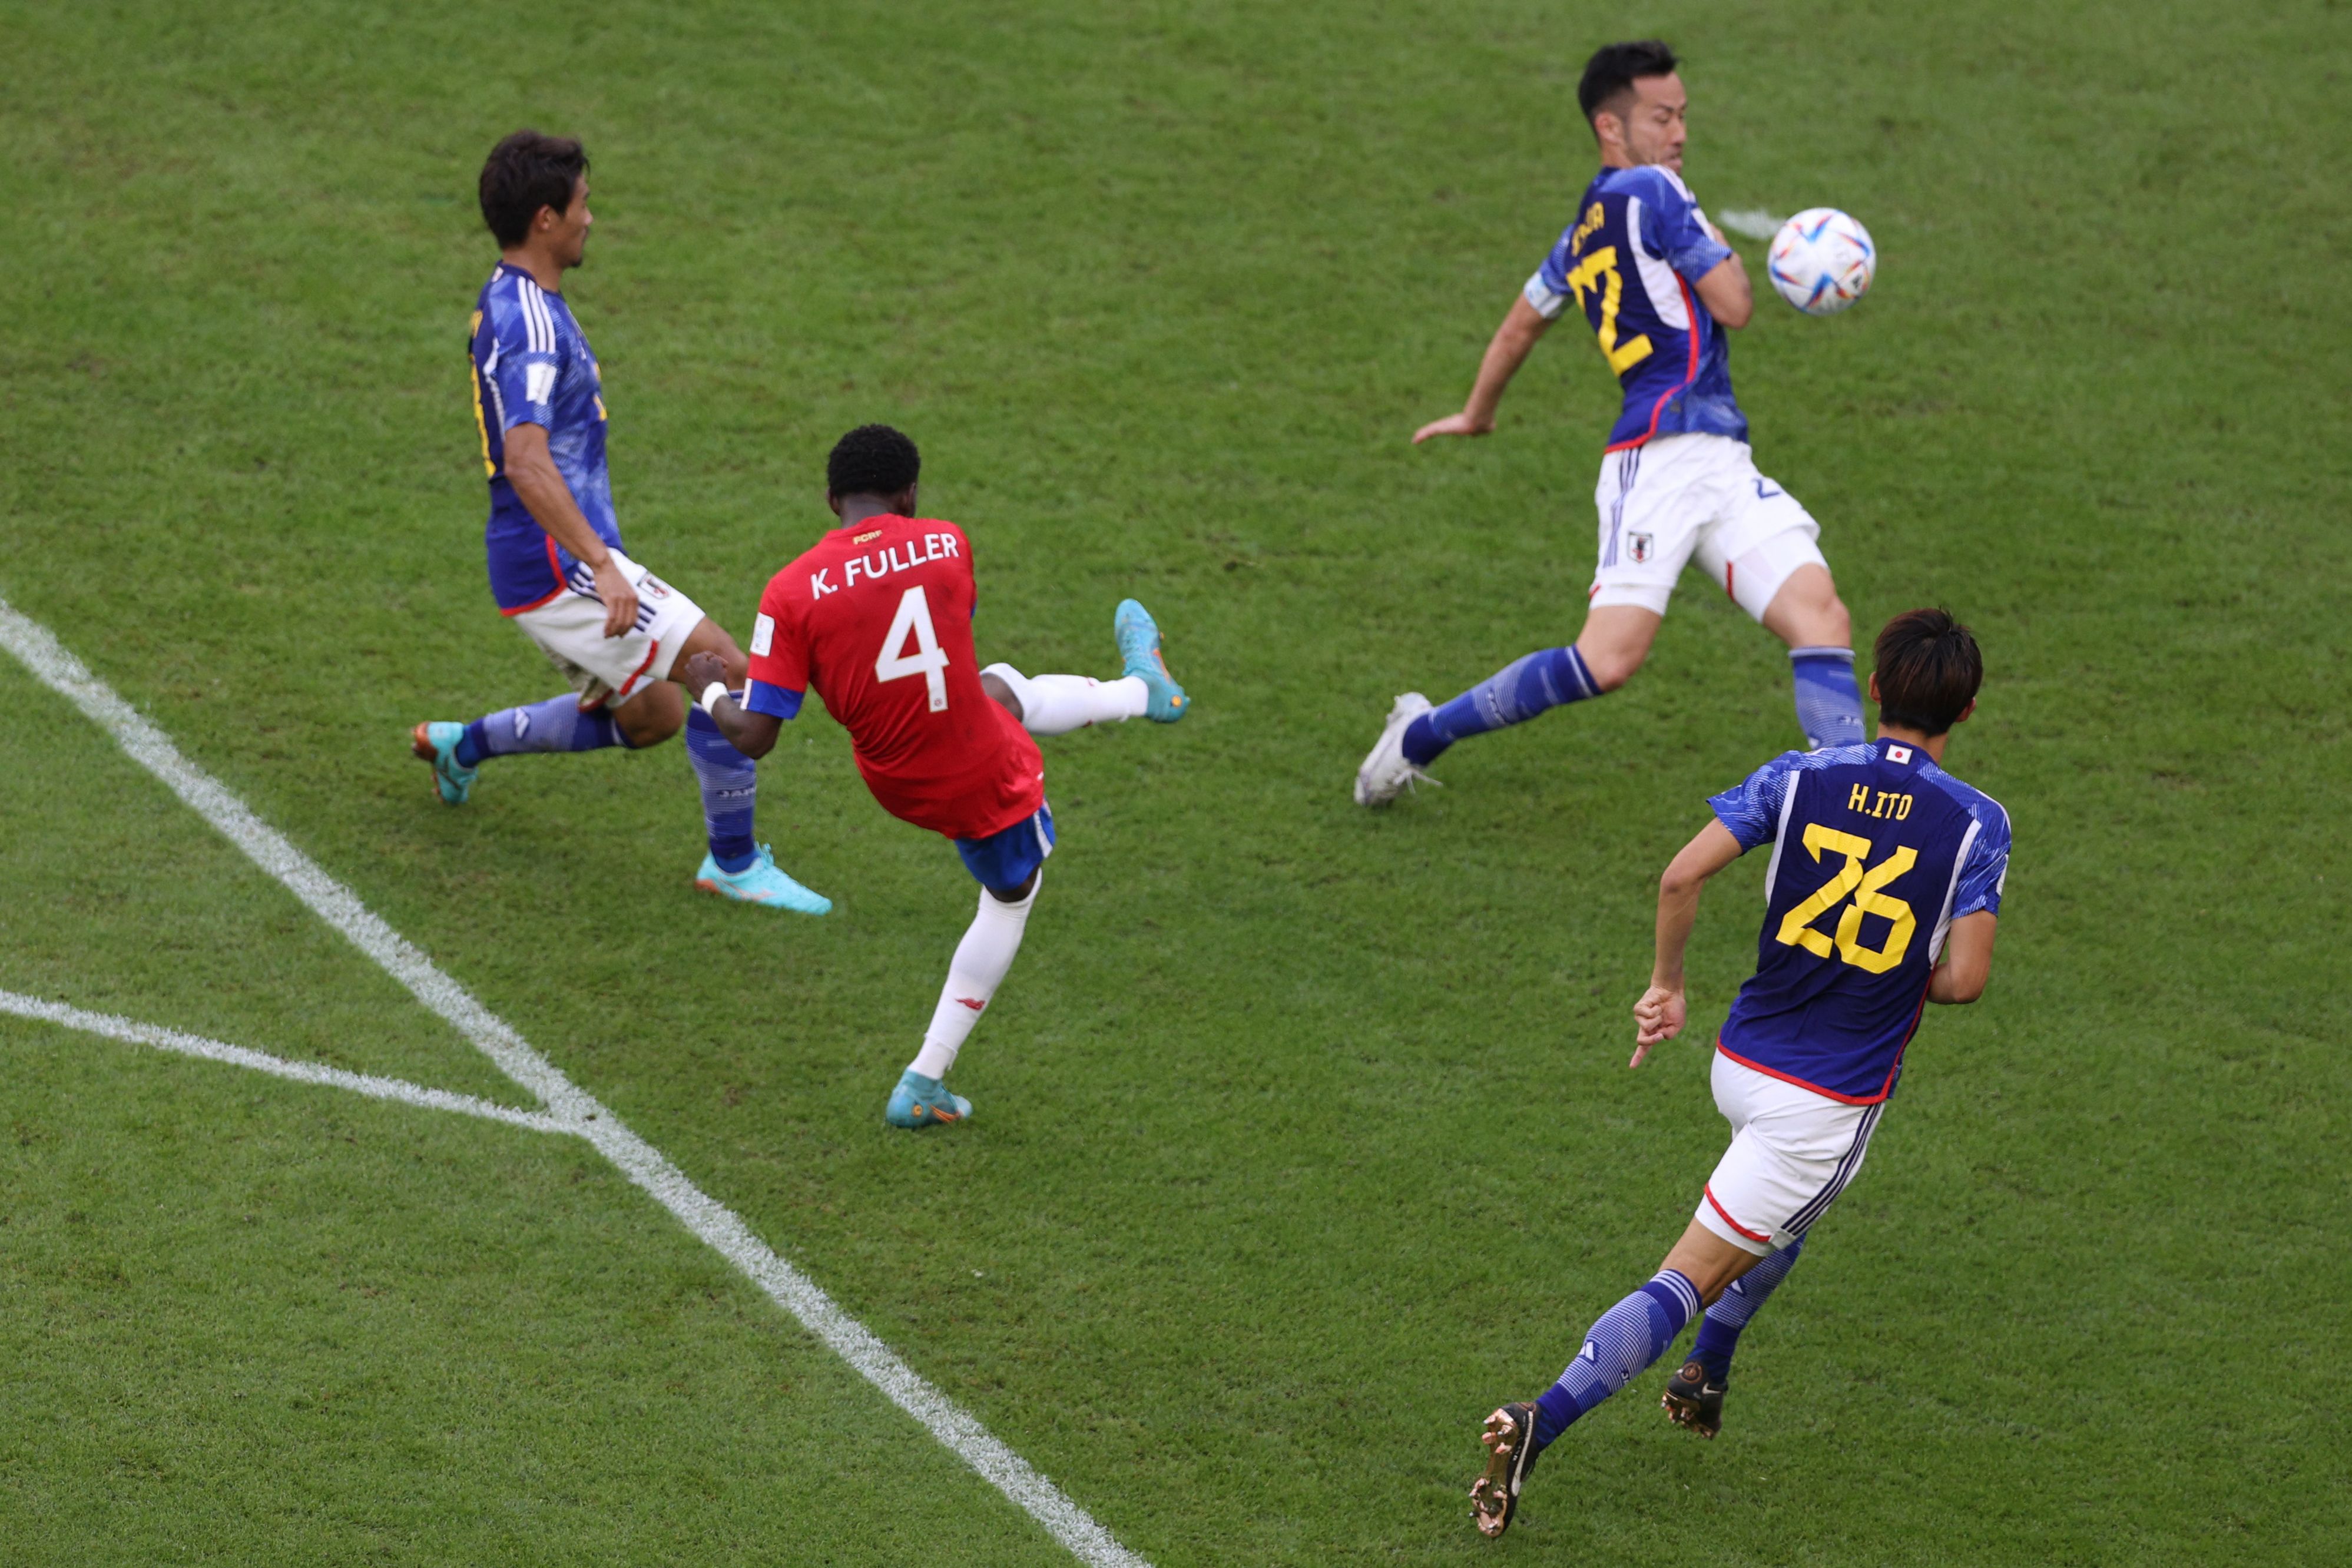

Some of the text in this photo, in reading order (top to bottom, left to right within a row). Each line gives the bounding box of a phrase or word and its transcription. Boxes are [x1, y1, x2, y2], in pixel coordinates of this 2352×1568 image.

[810, 532, 959, 600] K. FULLER
[853, 529, 882, 545] FCRF
[874, 585, 950, 713] 4
[1848, 783, 1913, 820] H.ITO
[1775, 822, 1918, 974] 26
